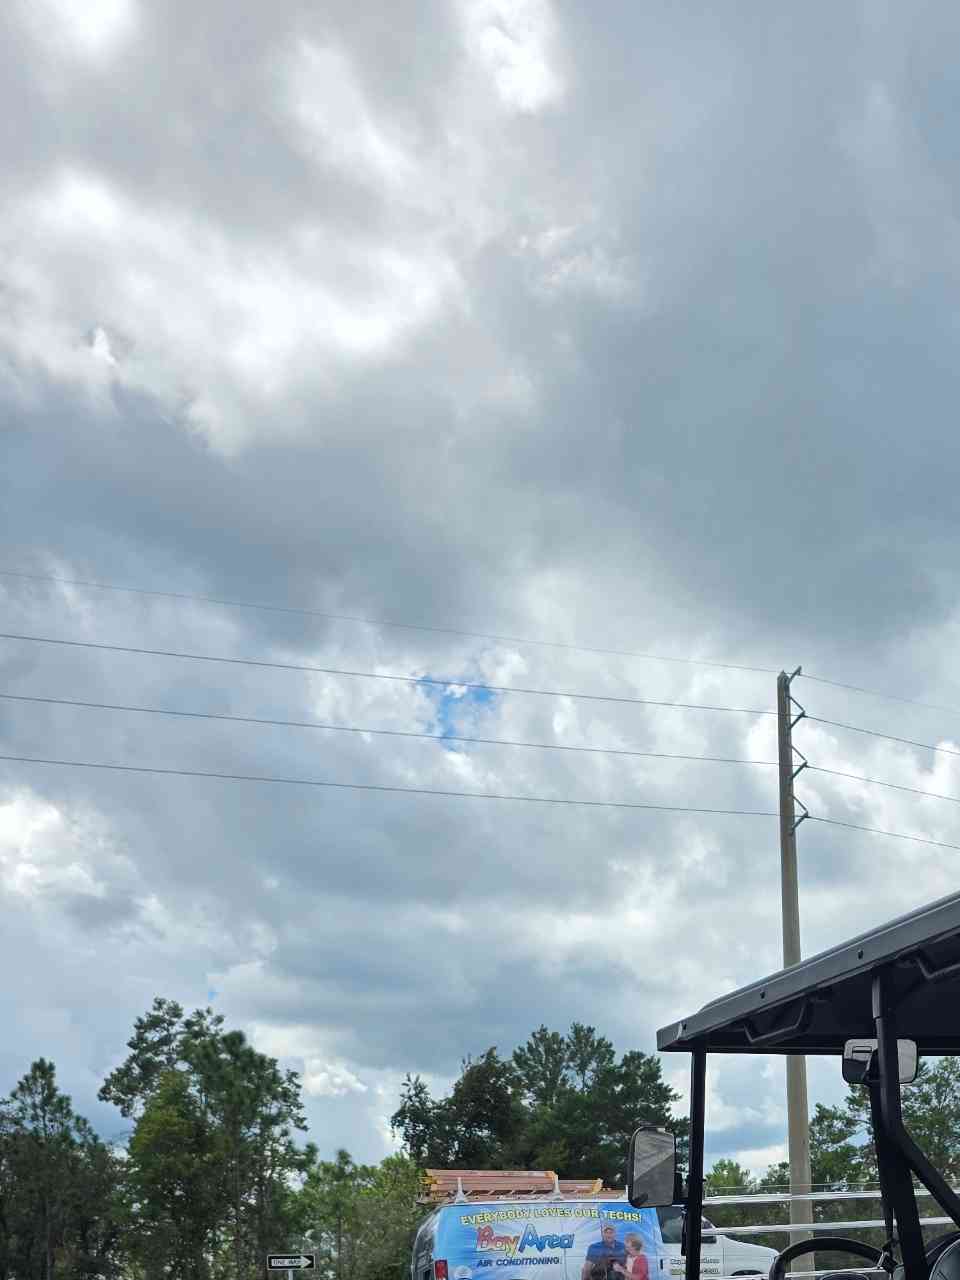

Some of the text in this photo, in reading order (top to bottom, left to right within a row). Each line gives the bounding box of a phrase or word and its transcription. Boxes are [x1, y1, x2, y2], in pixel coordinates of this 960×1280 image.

[460, 1208, 642, 1225] EVERYBODY LOVES OUR TECHS!
[475, 1223, 575, 1257] Bay Area
[476, 1256, 560, 1268] AIR CONDITIONING
